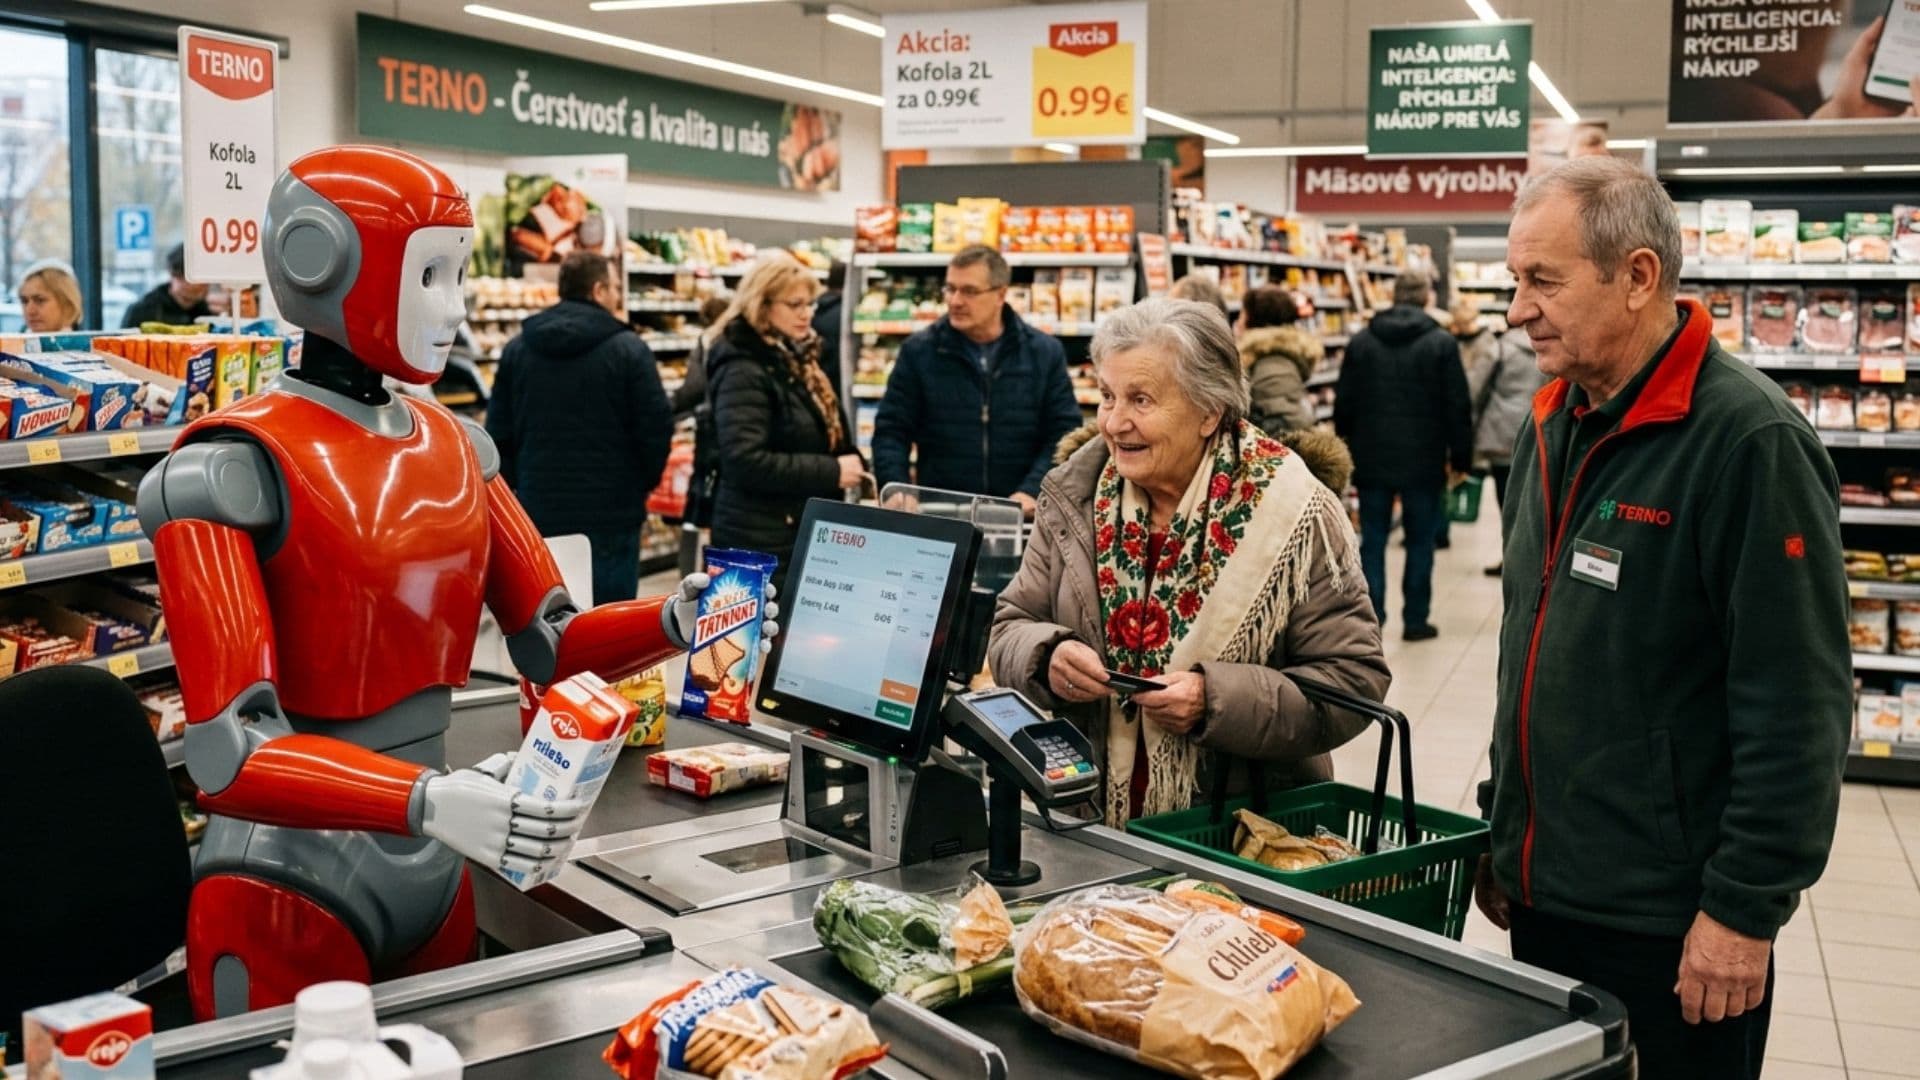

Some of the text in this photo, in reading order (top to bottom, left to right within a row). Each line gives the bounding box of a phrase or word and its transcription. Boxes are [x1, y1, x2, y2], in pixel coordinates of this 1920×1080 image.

[1684, 10, 1842, 32] INTELIGENCIA:
[897, 29, 971, 55] Akcia:
[1056, 27, 1110, 47] Akcia
[1683, 29, 1798, 56] RÝCHLEJŠÍ
[1388, 39, 1511, 64] NAŠA UMELÁ
[197, 48, 264, 83] TERNO
[897, 61, 993, 83] Kofola 2L
[1381, 67, 1517, 87] INTELIGENCIA:
[1682, 57, 1760, 79] NÁKUP
[377, 56, 488, 115] TERNO
[510, 68, 629, 137] Čerstvosť
[630, 108, 646, 140] a
[650, 103, 719, 150] kvalita
[721, 124, 736, 153] u
[738, 120, 771, 158] nás
[897, 88, 981, 109] za 0.99€
[1038, 86, 1129, 117] 0.99€
[1398, 84, 1498, 108] RÝCHLEJŠÍ
[1375, 108, 1522, 130] NÁKUP PRE VÁS
[209, 142, 257, 165] Kofola
[225, 172, 243, 190] 2L
[1305, 163, 1528, 200] Mäsové výrobky
[121, 210, 145, 249] P
[202, 217, 258, 254] 0.99
[1617, 503, 1671, 527] TERNO
